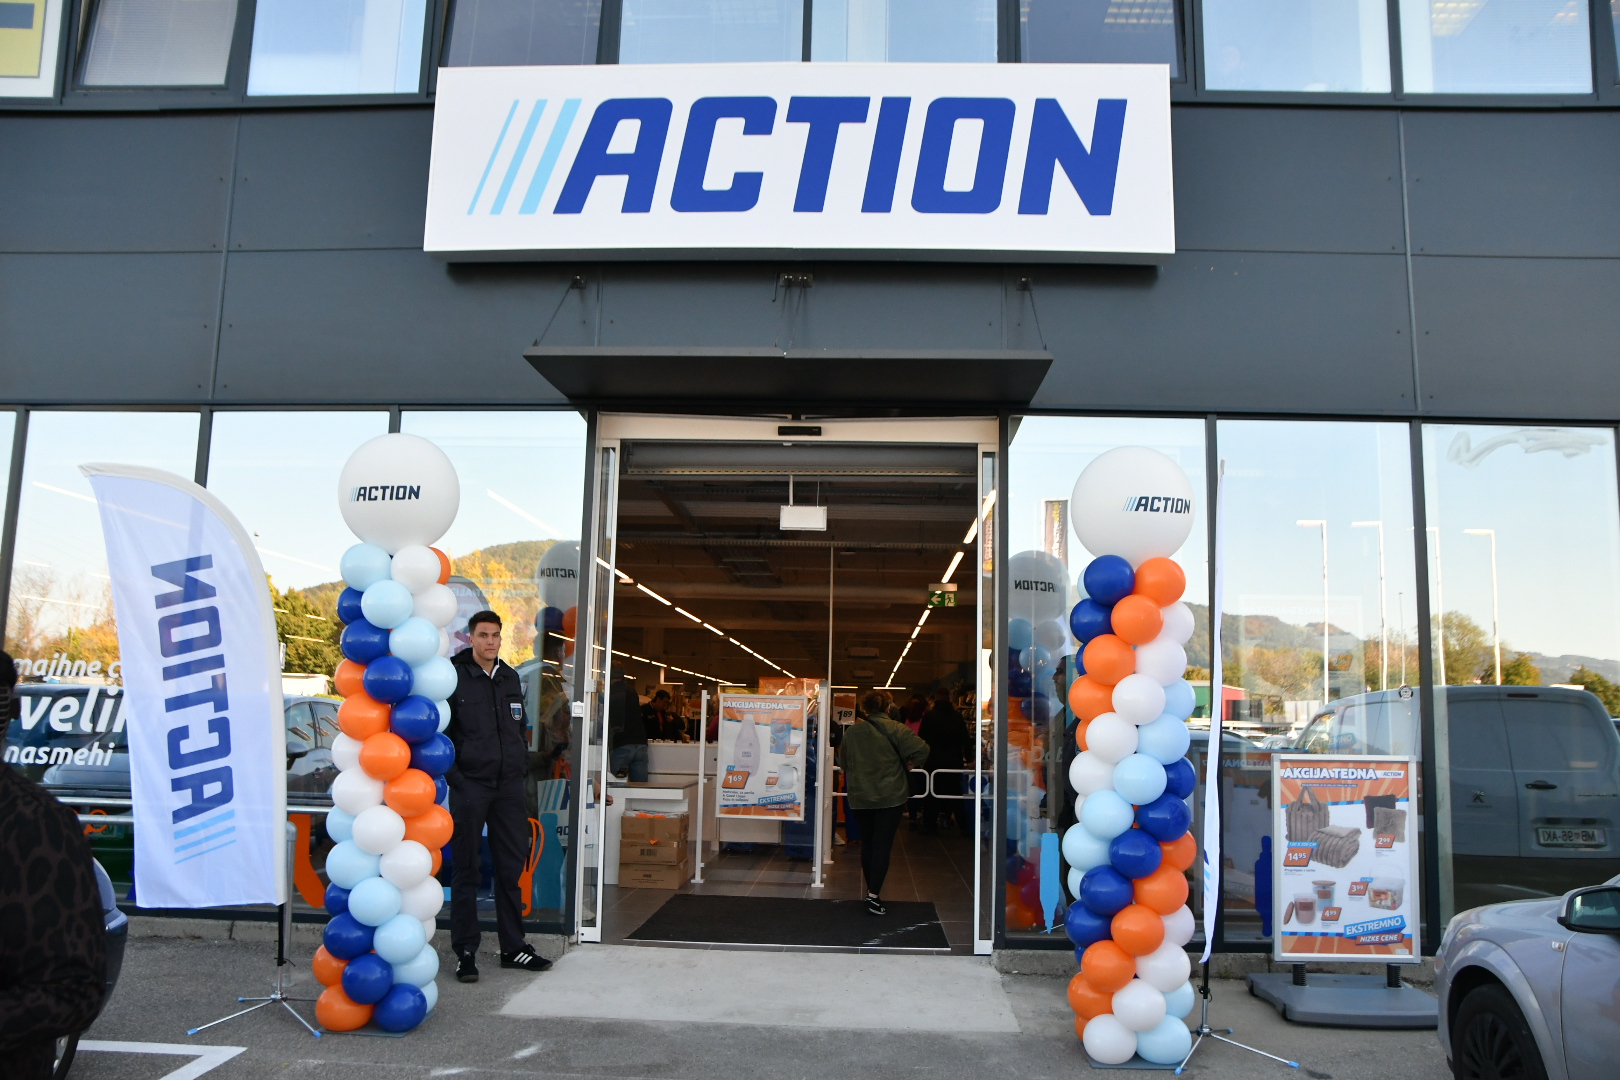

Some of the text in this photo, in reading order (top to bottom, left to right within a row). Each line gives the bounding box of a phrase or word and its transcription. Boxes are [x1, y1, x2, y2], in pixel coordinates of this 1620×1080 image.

[553, 96, 1128, 216] ACTION
[356, 485, 421, 501] ACTION
[1134, 496, 1191, 514] ACTION
[13, 653, 122, 682] majhne c
[726, 701, 756, 709] AKCIJA
[757, 702, 784, 710] TEDNA
[4, 742, 116, 766] nasmehi
[1284, 767, 1331, 779] AKCIJA
[1332, 768, 1377, 780] TEDNA
[1346, 917, 1402, 936] EKSTREMNO
[1360, 934, 1398, 943] NIZKE CENE
